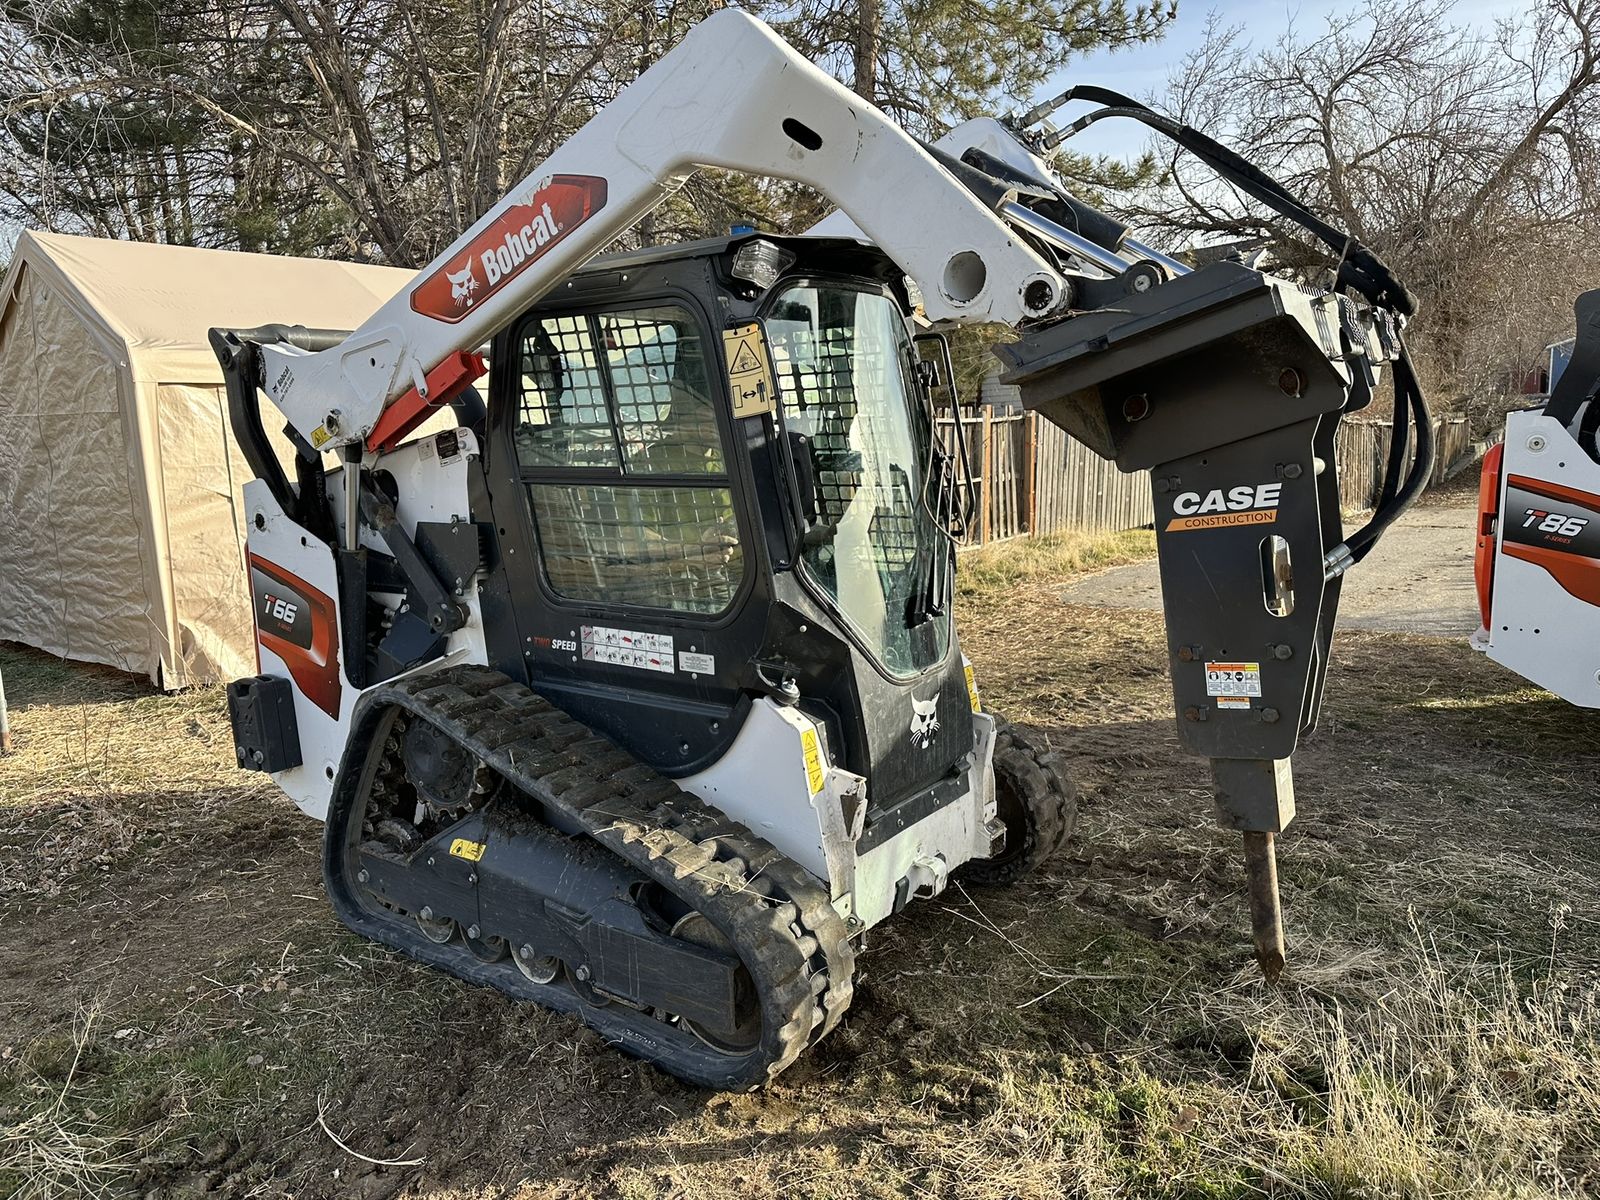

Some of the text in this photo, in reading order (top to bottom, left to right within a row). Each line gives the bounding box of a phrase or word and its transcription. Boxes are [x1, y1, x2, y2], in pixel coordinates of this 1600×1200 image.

[481, 203, 559, 286] Bobcat
[1173, 483, 1282, 515] CASE
[1184, 512, 1273, 528] CONSTRUCTION
[1522, 509, 1589, 537] T86
[264, 594, 298, 624] T66
[551, 639, 577, 652] SPEED
